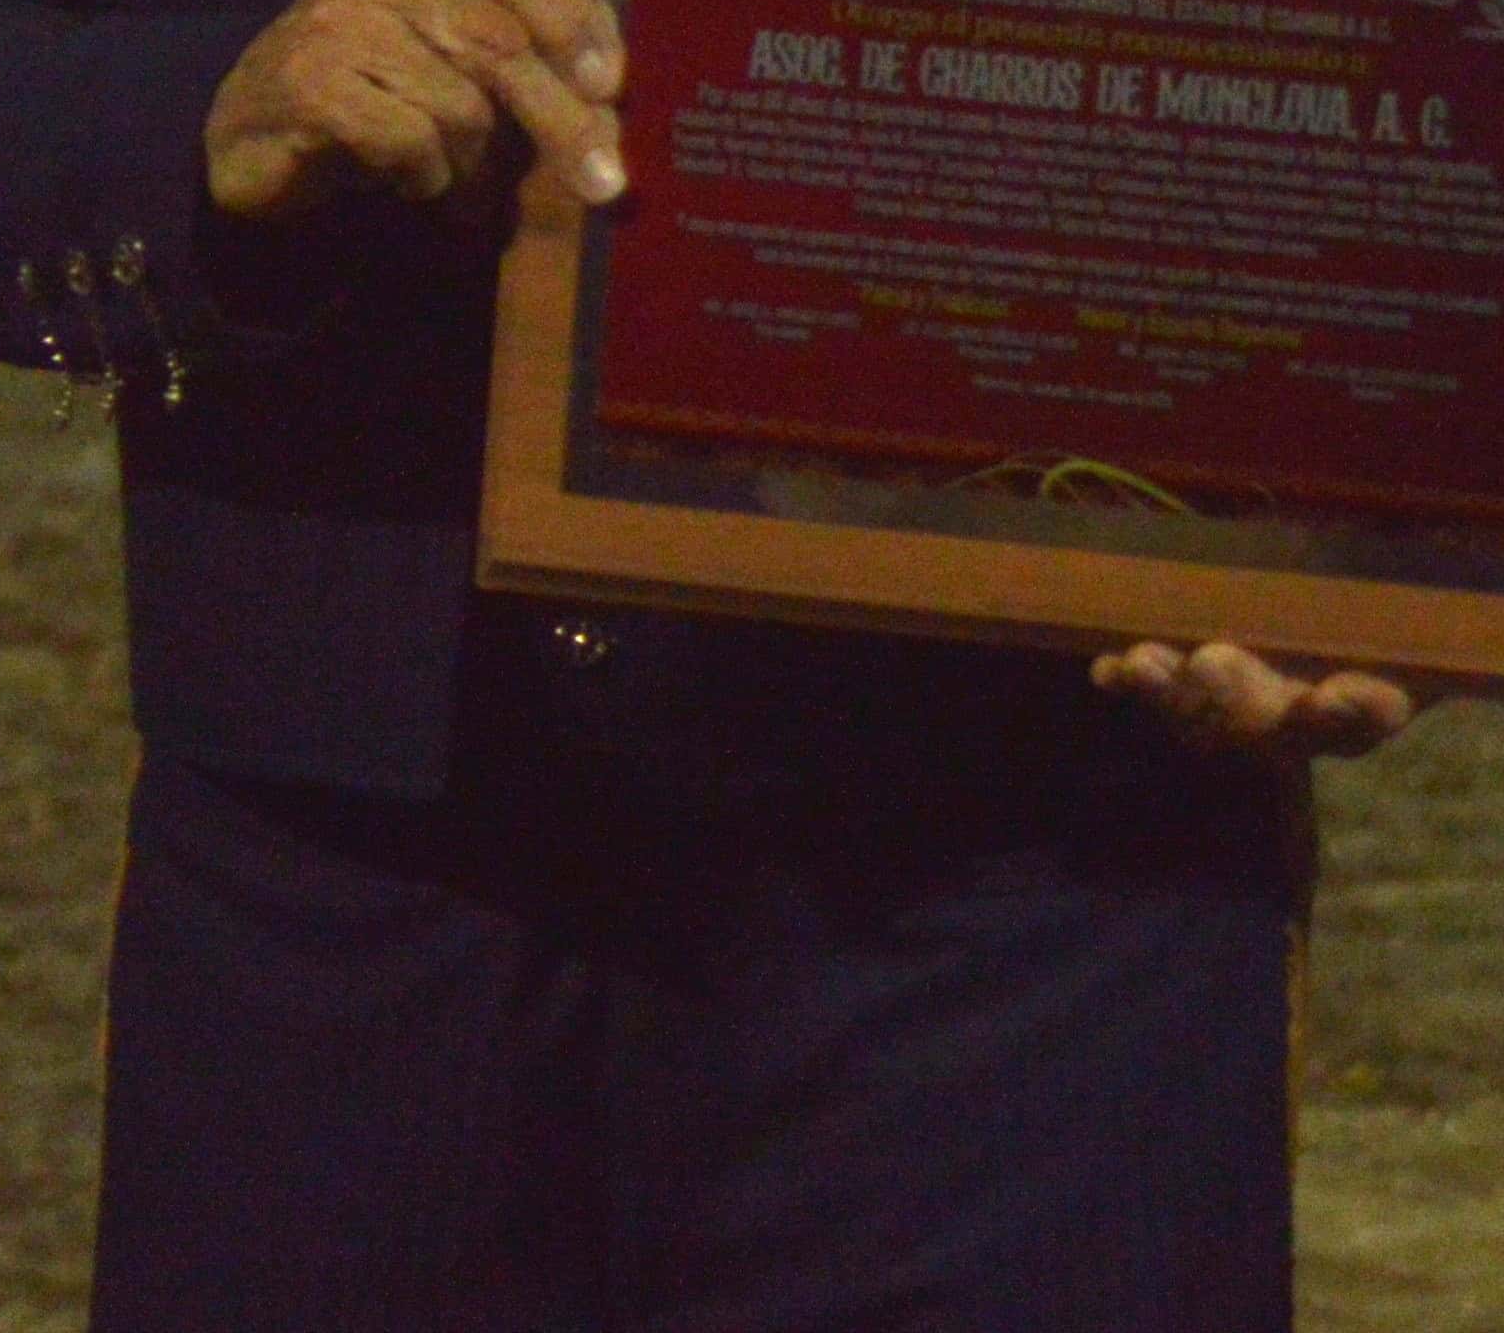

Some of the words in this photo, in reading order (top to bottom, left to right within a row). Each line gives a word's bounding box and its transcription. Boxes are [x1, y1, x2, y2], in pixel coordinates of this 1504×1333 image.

[748, 29, 847, 87] ASOC.
[859, 37, 907, 95] DE
[919, 44, 1084, 111] CHARROS
[1099, 62, 1145, 118] DE
